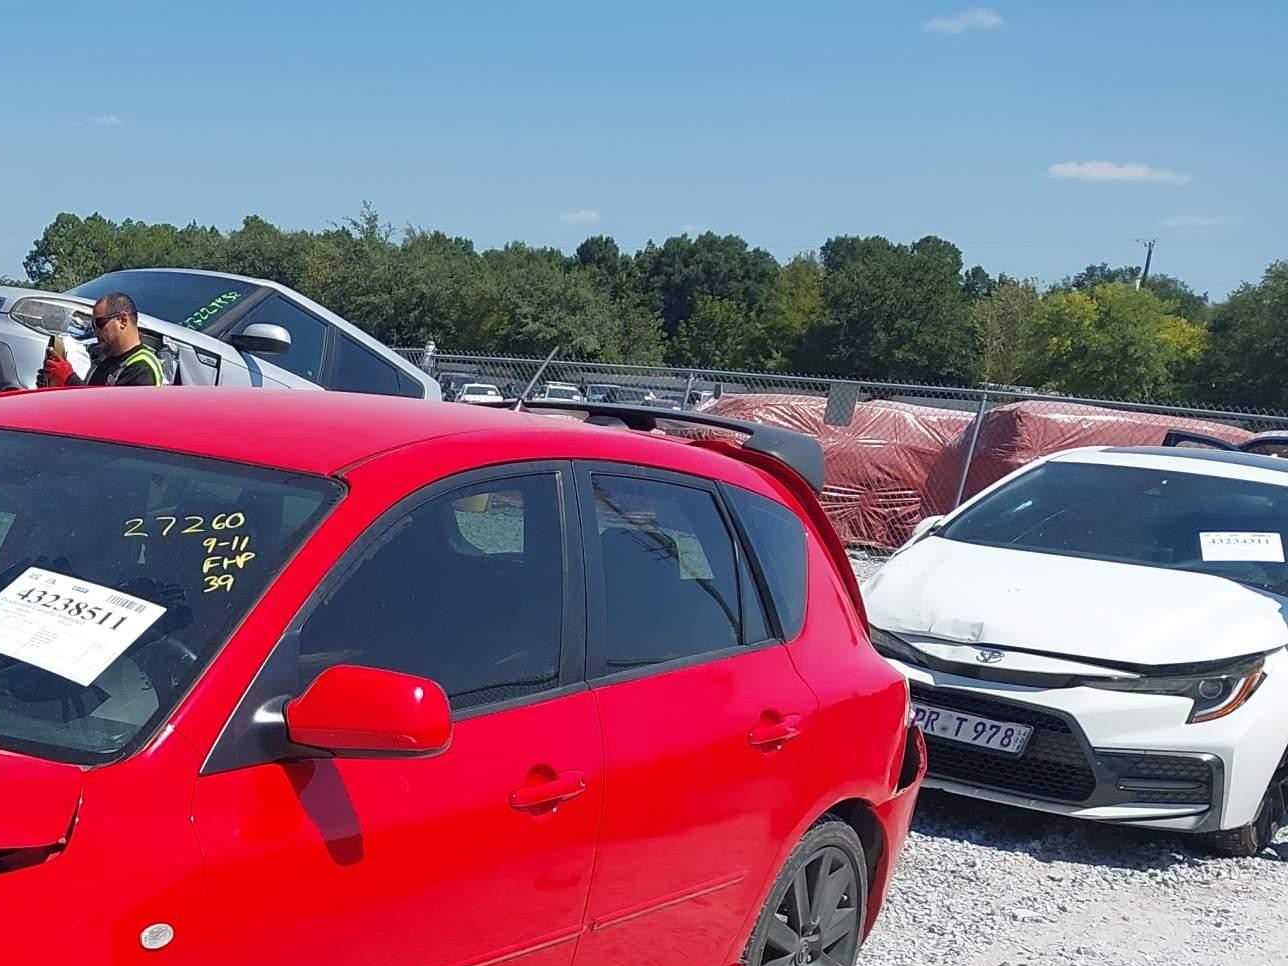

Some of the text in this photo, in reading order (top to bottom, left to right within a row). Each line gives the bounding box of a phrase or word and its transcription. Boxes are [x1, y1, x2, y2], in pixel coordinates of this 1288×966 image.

[123, 512, 245, 538] 27260
[202, 536, 250, 553] 9-11
[203, 574, 235, 593] 39
[16, 587, 128, 631] 43238511
[912, 707, 940, 732] PR
[954, 716, 968, 737] T
[972, 721, 1015, 748] 978
